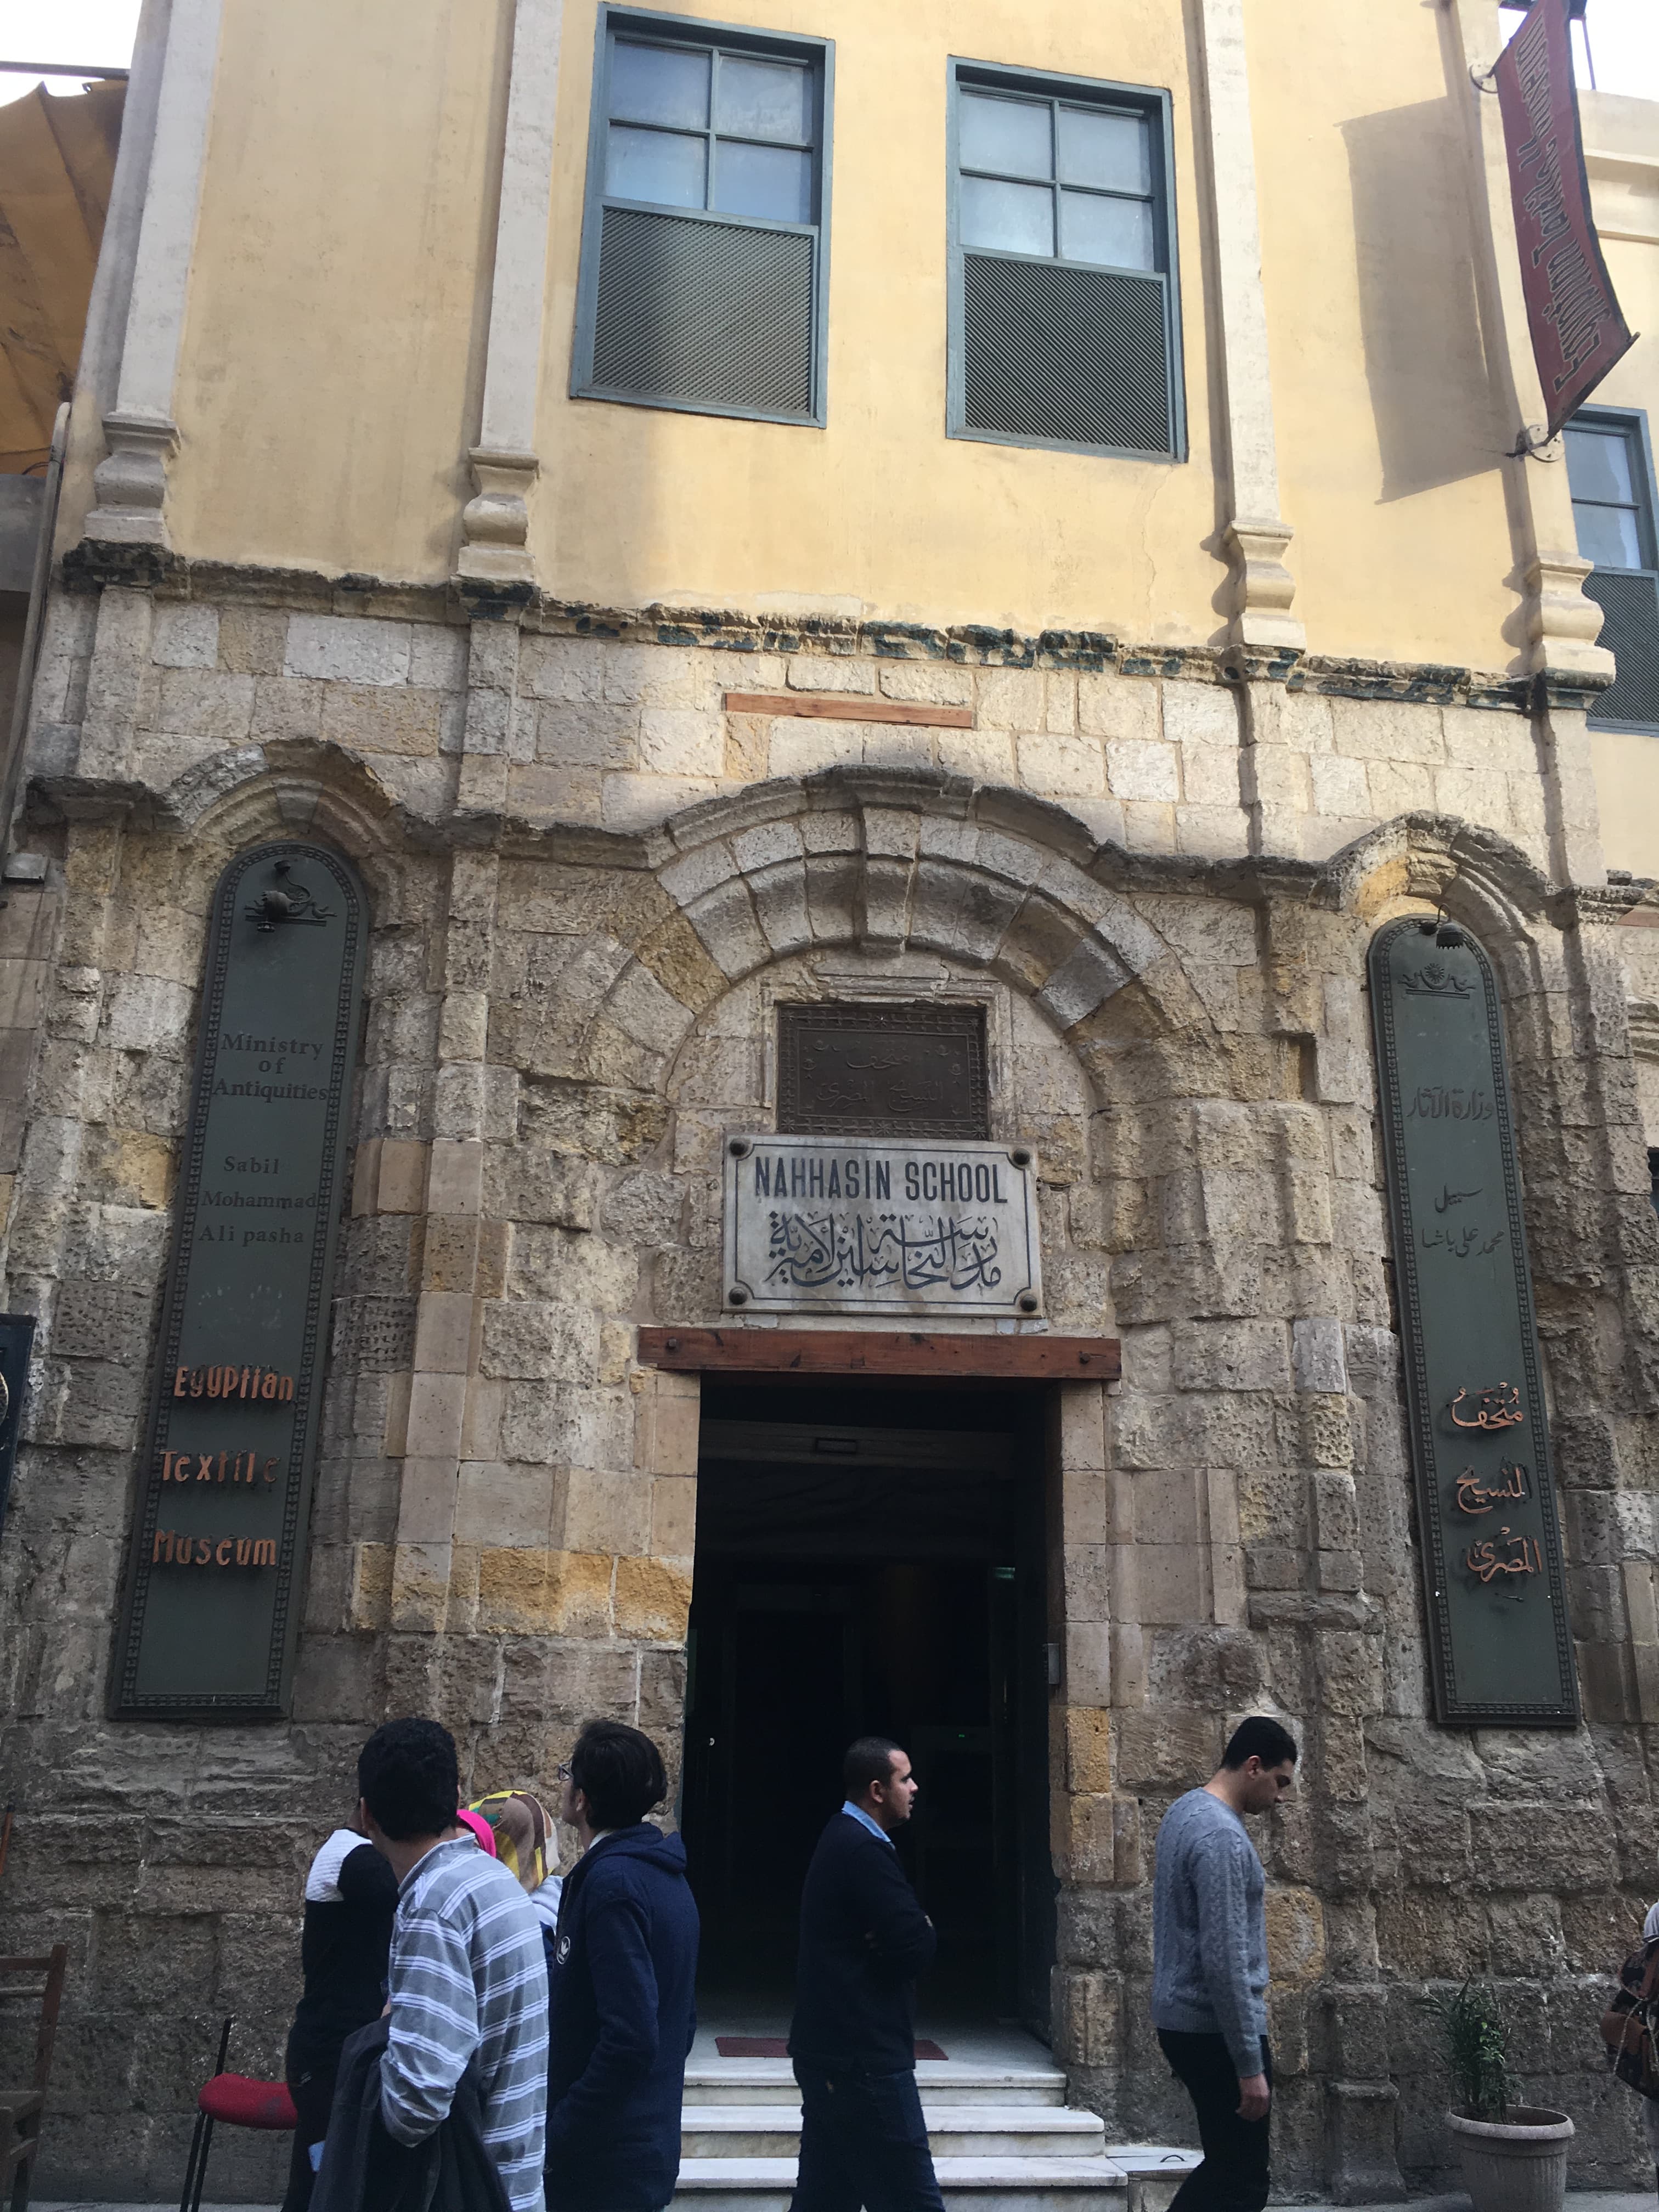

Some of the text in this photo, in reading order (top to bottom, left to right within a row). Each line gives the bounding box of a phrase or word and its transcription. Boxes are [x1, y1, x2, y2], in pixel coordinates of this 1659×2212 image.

[1515, 13, 1553, 169] Museum
[1542, 238, 1610, 394] Egyptian
[222, 1033, 323, 1059] Ministry
[258, 1058, 286, 1074] of
[212, 1079, 329, 1103] Antiquities
[1407, 1086, 1494, 1120] وزارة الآثار
[224, 1156, 279, 1175] Sabil
[755, 1156, 1007, 1204] NAHHASIN SCHOOL
[201, 1190, 318, 1210] Mohammad
[1435, 1183, 1483, 1213] سبيل
[198, 1225, 304, 1247] Ali pasha
[1422, 1228, 1455, 1252] باشا
[1476, 1230, 1504, 1256] محمد
[174, 1365, 295, 1401] Egyptian
[160, 1450, 280, 1484] Textile
[153, 1530, 277, 1566] Museum
